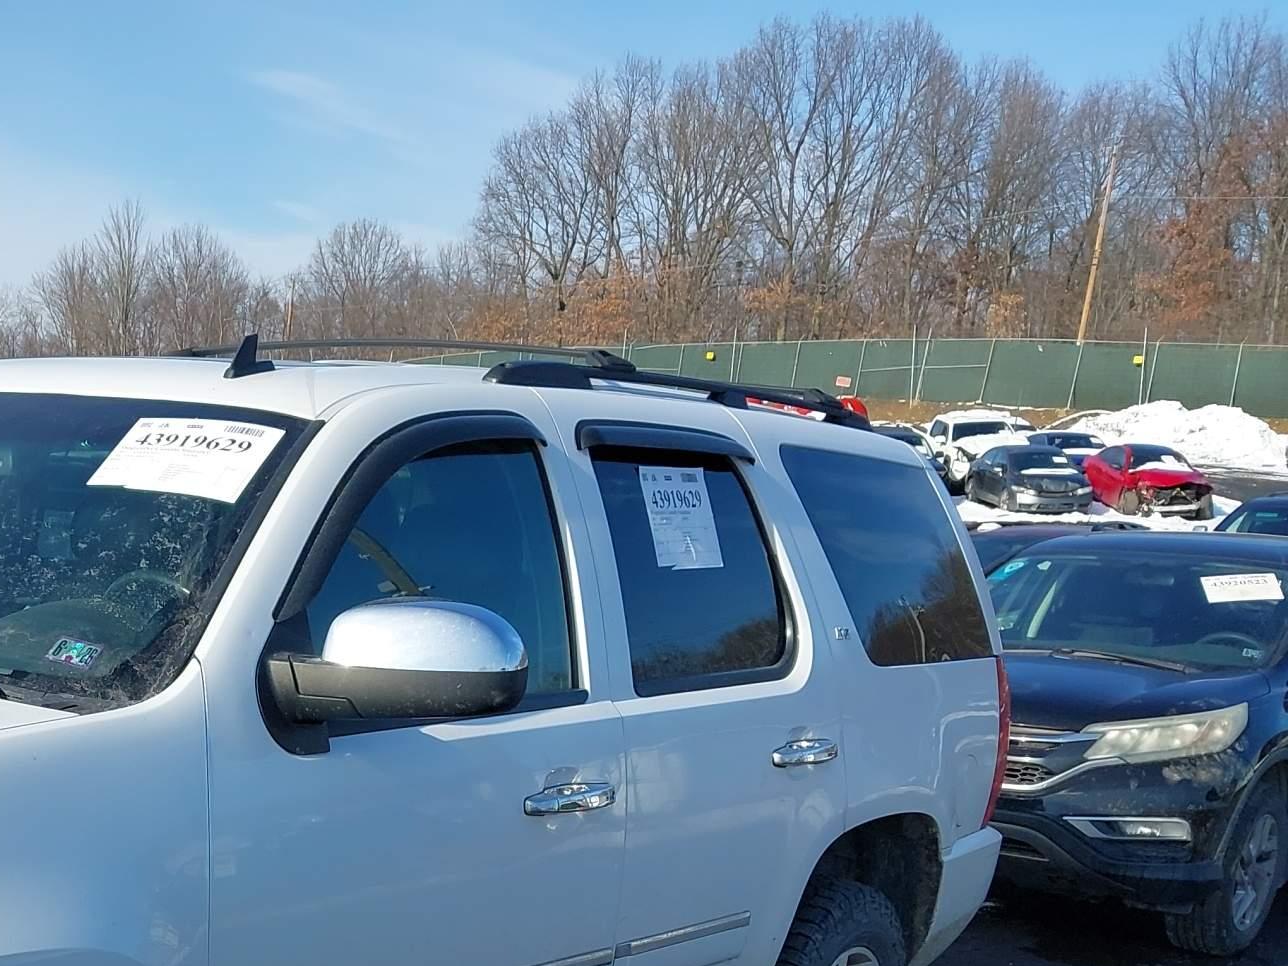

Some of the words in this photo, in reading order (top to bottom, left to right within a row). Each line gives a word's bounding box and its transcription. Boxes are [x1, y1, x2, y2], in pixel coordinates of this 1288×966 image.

[135, 433, 253, 453] 43919629
[652, 490, 702, 508] 43919629
[52, 640, 68, 656] 6
[78, 647, 99, 665] 26
